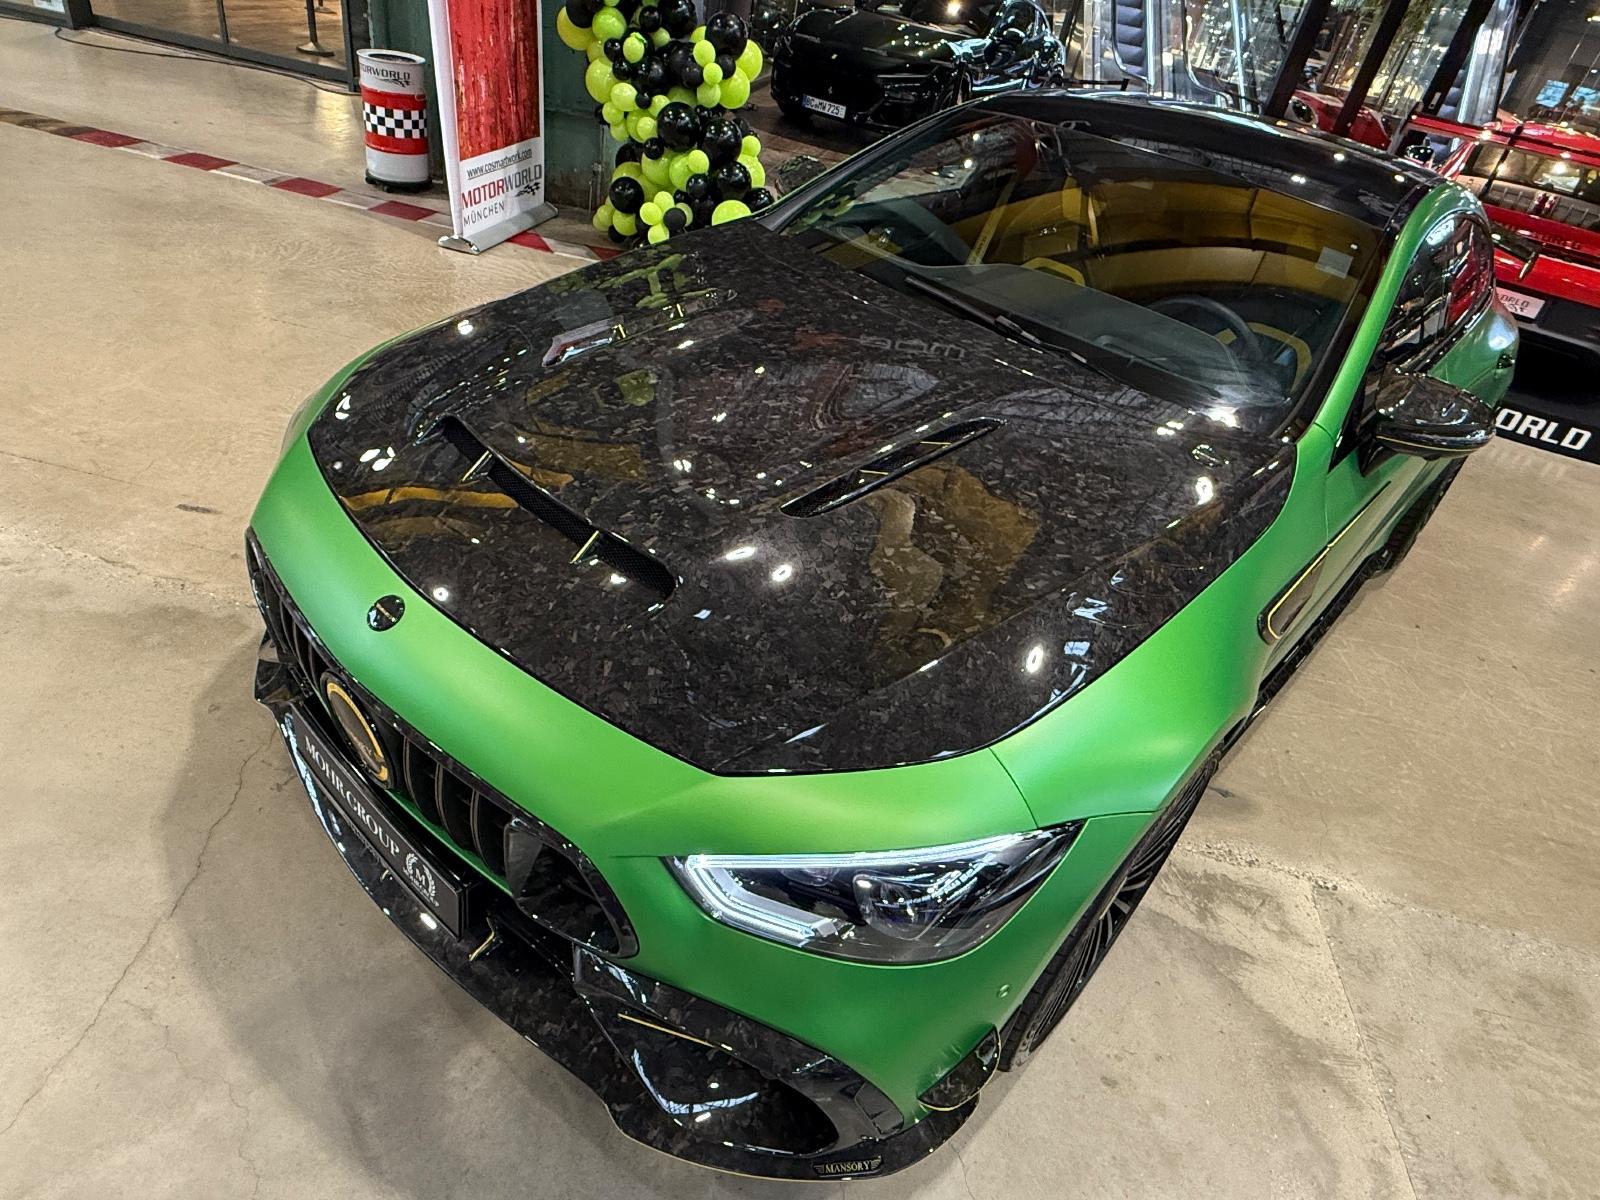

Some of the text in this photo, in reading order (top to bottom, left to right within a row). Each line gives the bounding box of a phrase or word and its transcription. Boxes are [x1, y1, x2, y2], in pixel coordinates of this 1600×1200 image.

[461, 164, 542, 209] MOTORWORLD
[463, 201, 505, 227] MÜNCHEN
[1495, 407, 1592, 450] ORLD
[305, 736, 400, 856] MOHR GROUP
[825, 1161, 870, 1174] MANSORY
